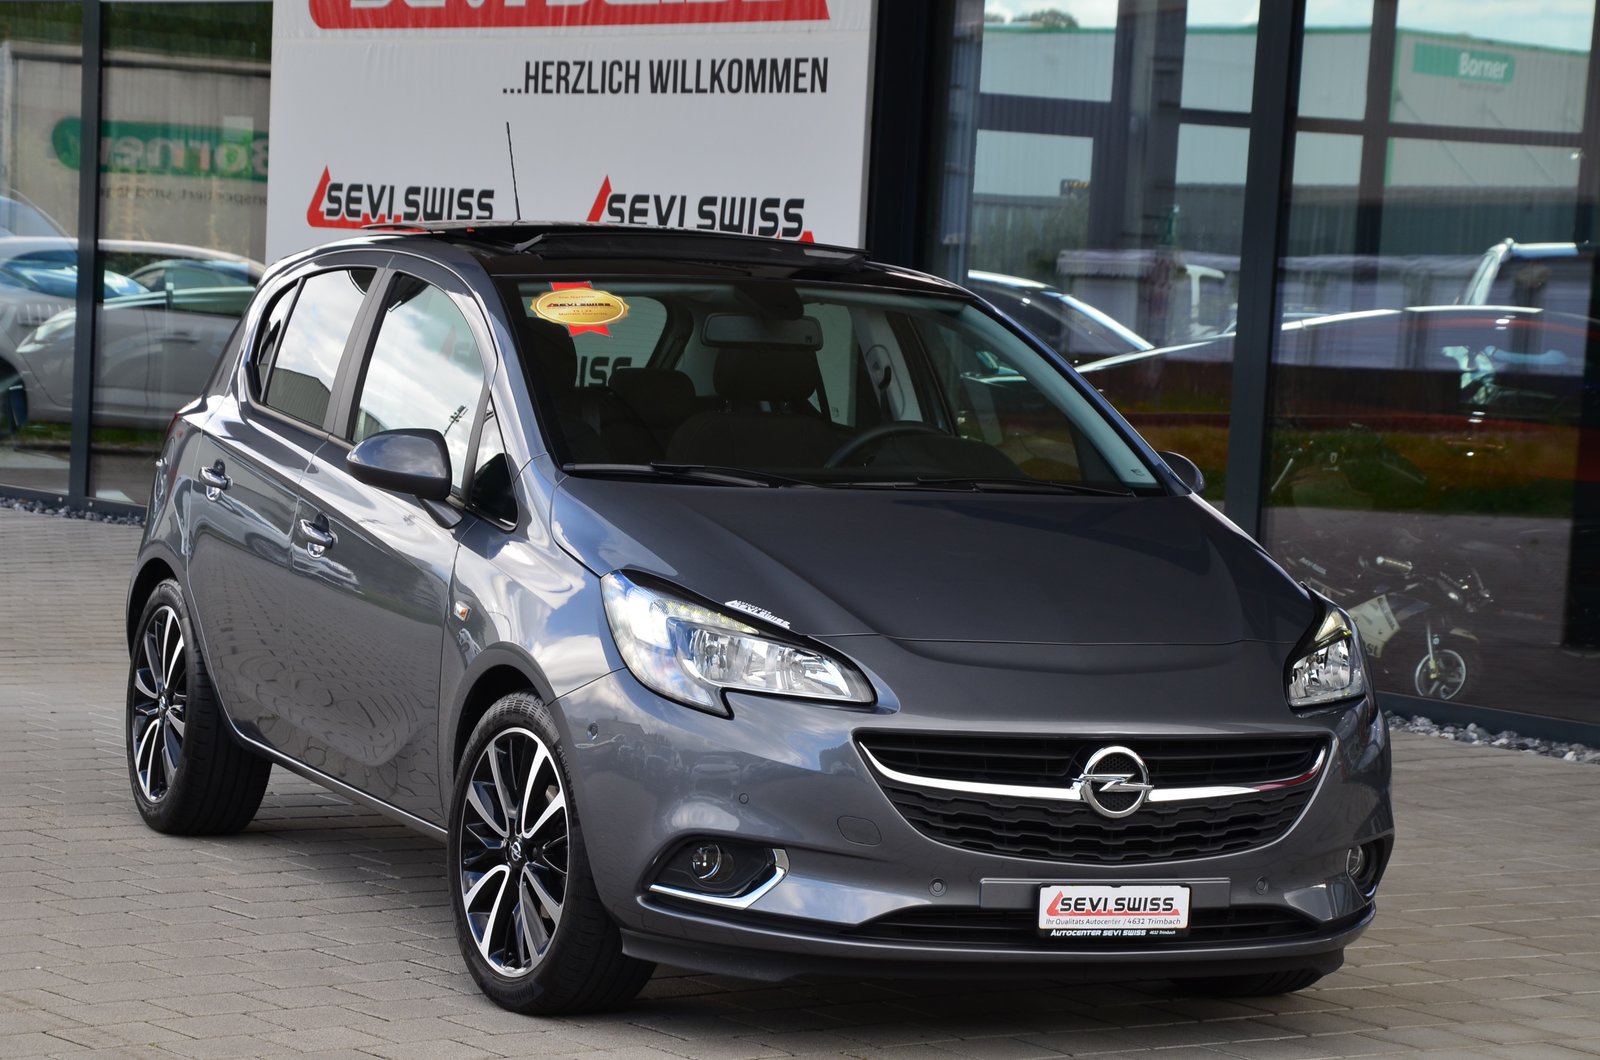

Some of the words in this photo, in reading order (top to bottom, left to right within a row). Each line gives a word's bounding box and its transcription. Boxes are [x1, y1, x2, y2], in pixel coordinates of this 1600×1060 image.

[648, 57, 829, 94] WILLKOMMEN
[1458, 52, 1509, 80] Borner
[325, 183, 395, 220] SEVI
[403, 186, 495, 221] SWISS
[607, 193, 687, 228] SEVI
[696, 196, 805, 237] SWISS
[1059, 897, 1108, 912] SEVI
[1113, 897, 1174, 912] SWISS
[1085, 917, 1121, 925] Autocenter
[1127, 917, 1145, 925] 4632
[1148, 917, 1181, 925] Trimbach
